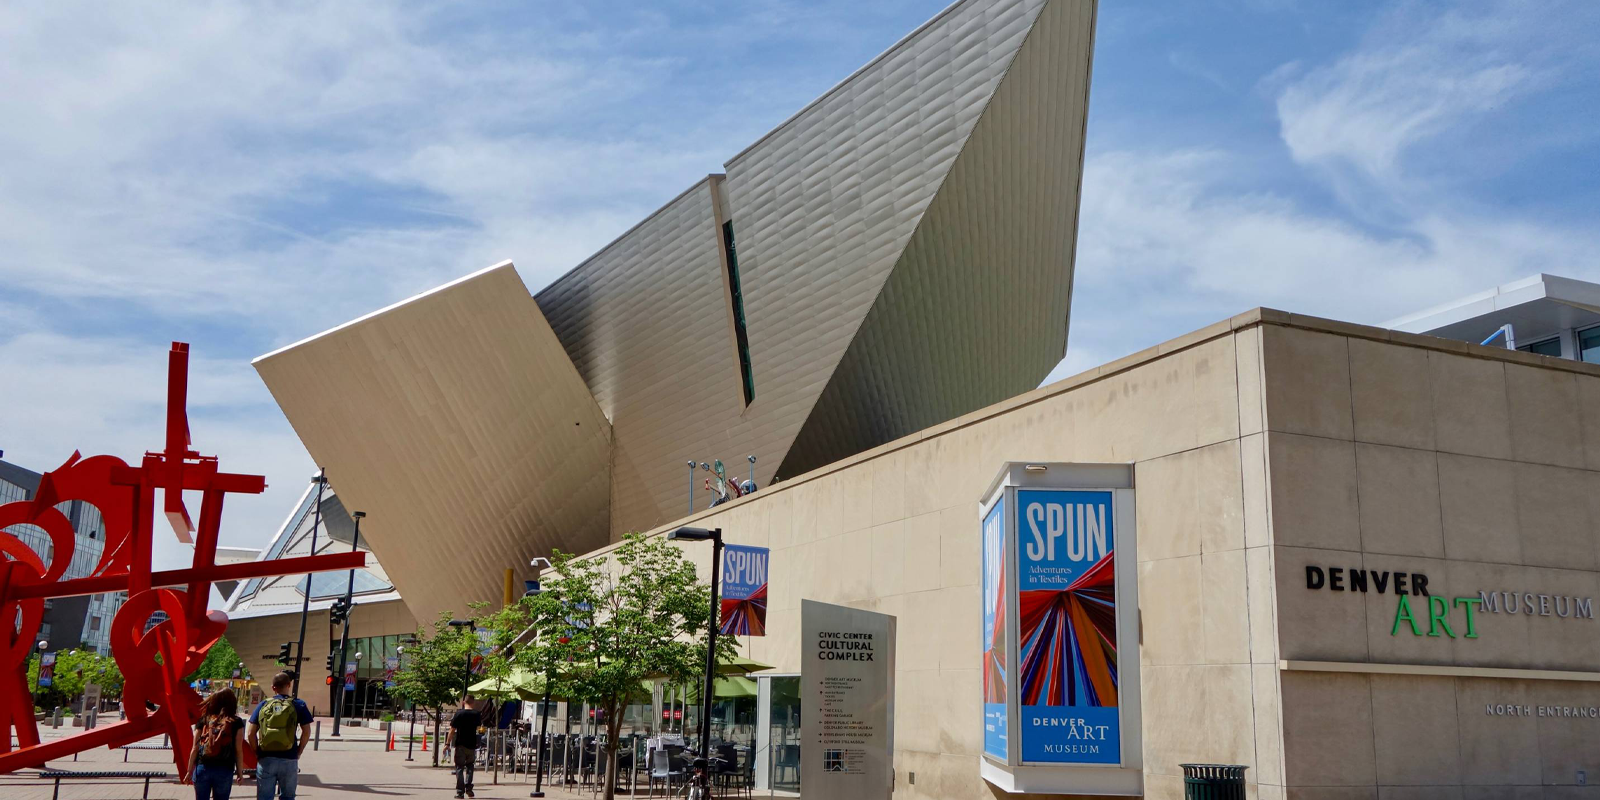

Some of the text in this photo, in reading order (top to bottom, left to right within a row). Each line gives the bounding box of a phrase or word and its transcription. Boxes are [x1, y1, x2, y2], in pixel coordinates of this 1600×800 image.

[1026, 501, 1107, 562] SPUN
[725, 550, 766, 586] SPUN
[1029, 565, 1072, 575] Adventures
[1029, 574, 1068, 584] in Textiles
[1305, 565, 1430, 597] DENVER
[1391, 591, 1594, 639] ART MUSEUM
[818, 631, 873, 640] CIVIC CENTER
[818, 640, 874, 651] CULTURAL
[818, 651, 874, 662] COMPLEX
[1485, 704, 1600, 718] NORTH ENTRANC
[1033, 717, 1085, 728] DENVER
[1067, 724, 1109, 740] ART
[1044, 743, 1100, 754] MUSEUM
